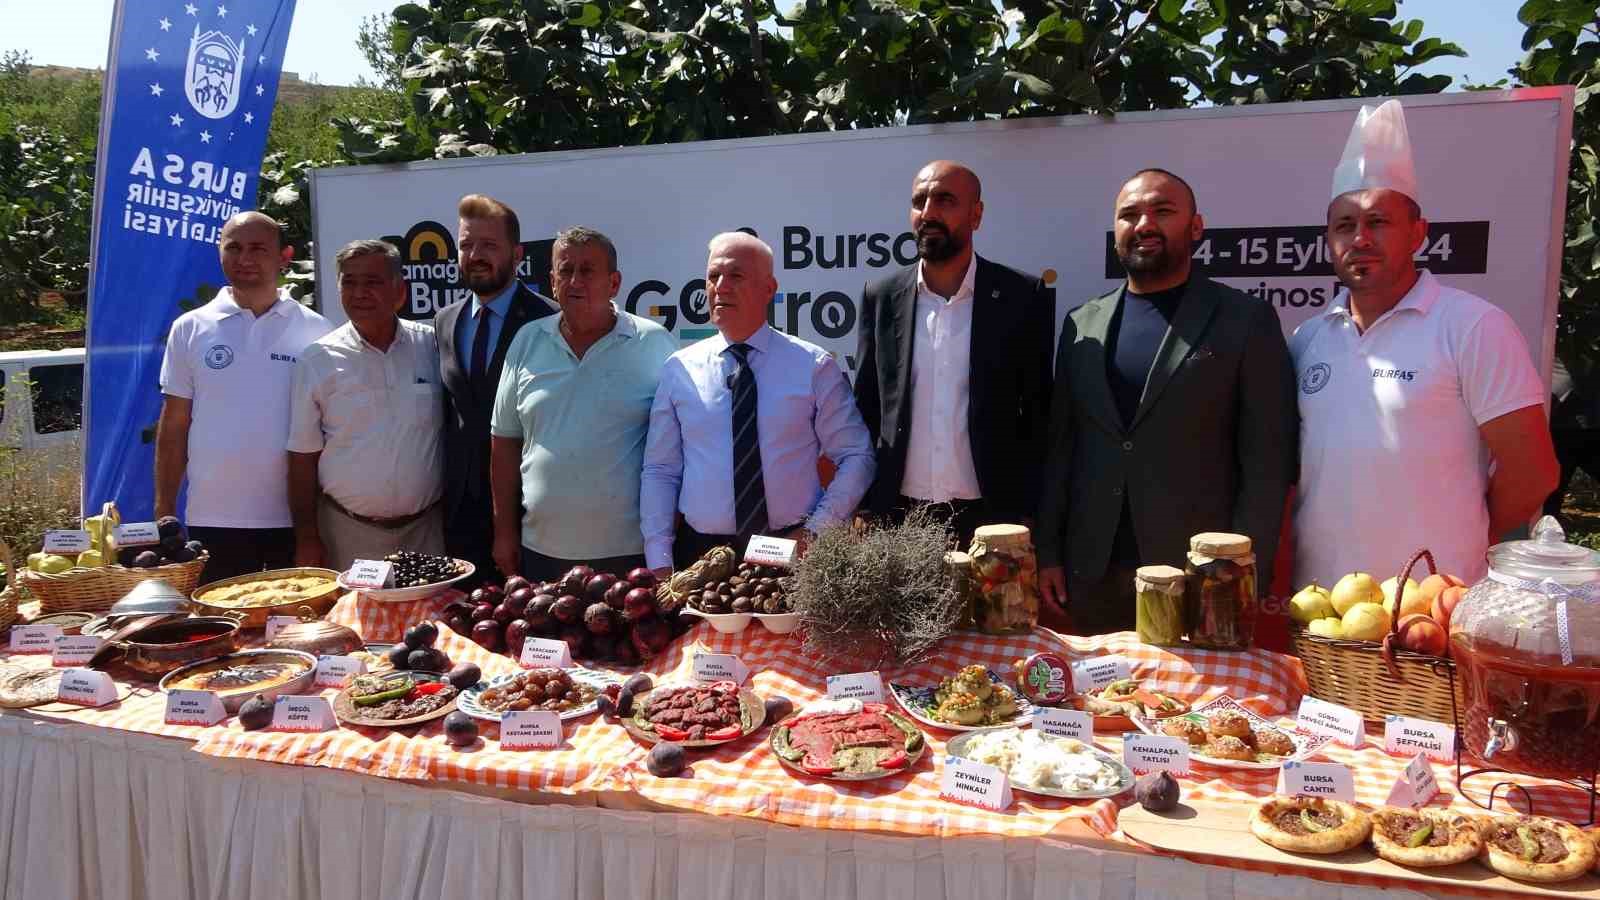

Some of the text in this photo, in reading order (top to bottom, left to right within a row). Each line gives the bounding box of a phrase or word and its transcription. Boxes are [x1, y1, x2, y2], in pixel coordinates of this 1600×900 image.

[1191, 238, 1213, 265] 4
[1236, 238, 1268, 265] 15
[1276, 235, 1332, 272] Eyl
[1412, 232, 1452, 262] 24
[411, 282, 472, 314] Bur
[1042, 719, 1082, 729] HASANAĞA
[1403, 728, 1435, 739] BURSA
[1395, 737, 1441, 751] ŞEFTALİSİ
[1132, 746, 1180, 756] KEMALPAŞA
[1141, 755, 1170, 764] TATLISI
[954, 771, 992, 785] ZEYNİLER
[1303, 775, 1334, 783] BURSA
[956, 782, 987, 795] HINKALI
[1303, 785, 1337, 794] CANTIK
